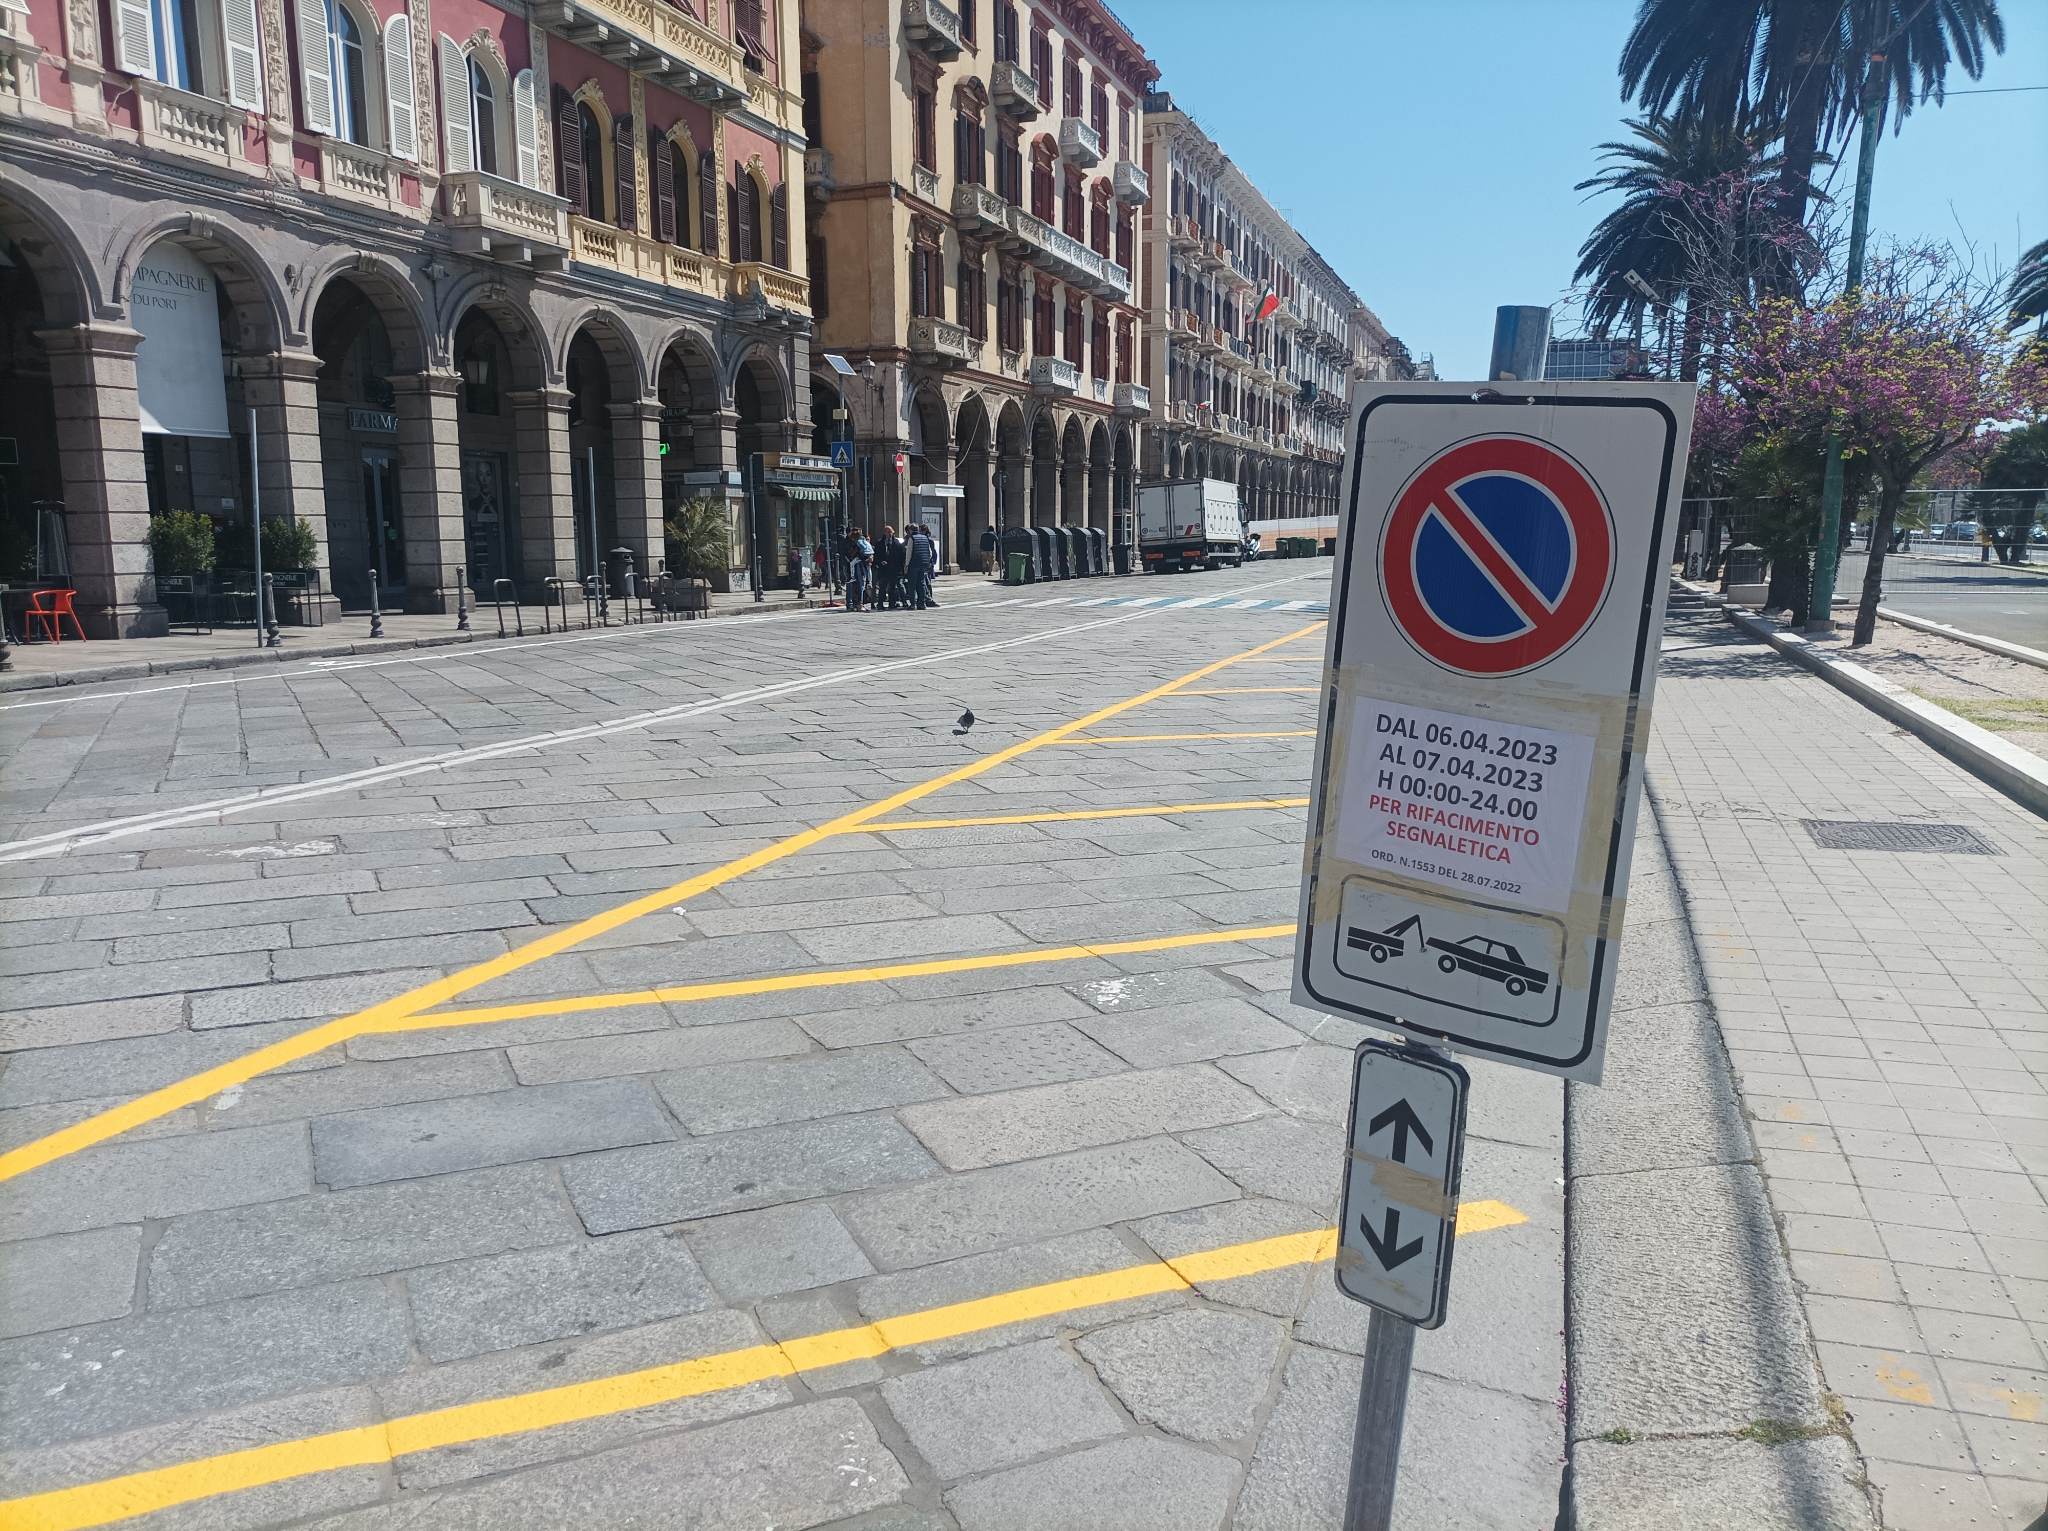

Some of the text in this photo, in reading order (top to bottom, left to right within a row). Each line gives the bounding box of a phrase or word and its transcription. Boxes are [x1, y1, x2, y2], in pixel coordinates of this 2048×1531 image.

[133, 293, 177, 310] DU PORT
[1376, 713, 1558, 766] DAL 06.04.2023
[1378, 742, 1544, 793] AL 07.04.2023
[1370, 794, 1540, 846] PER RIFACIMENTO
[1378, 769, 1538, 821] H 00:00-24.00
[1386, 820, 1511, 865] SEGNALETICA
[1371, 849, 1522, 895] ORD. N.1553 DEL 28.07.2022
